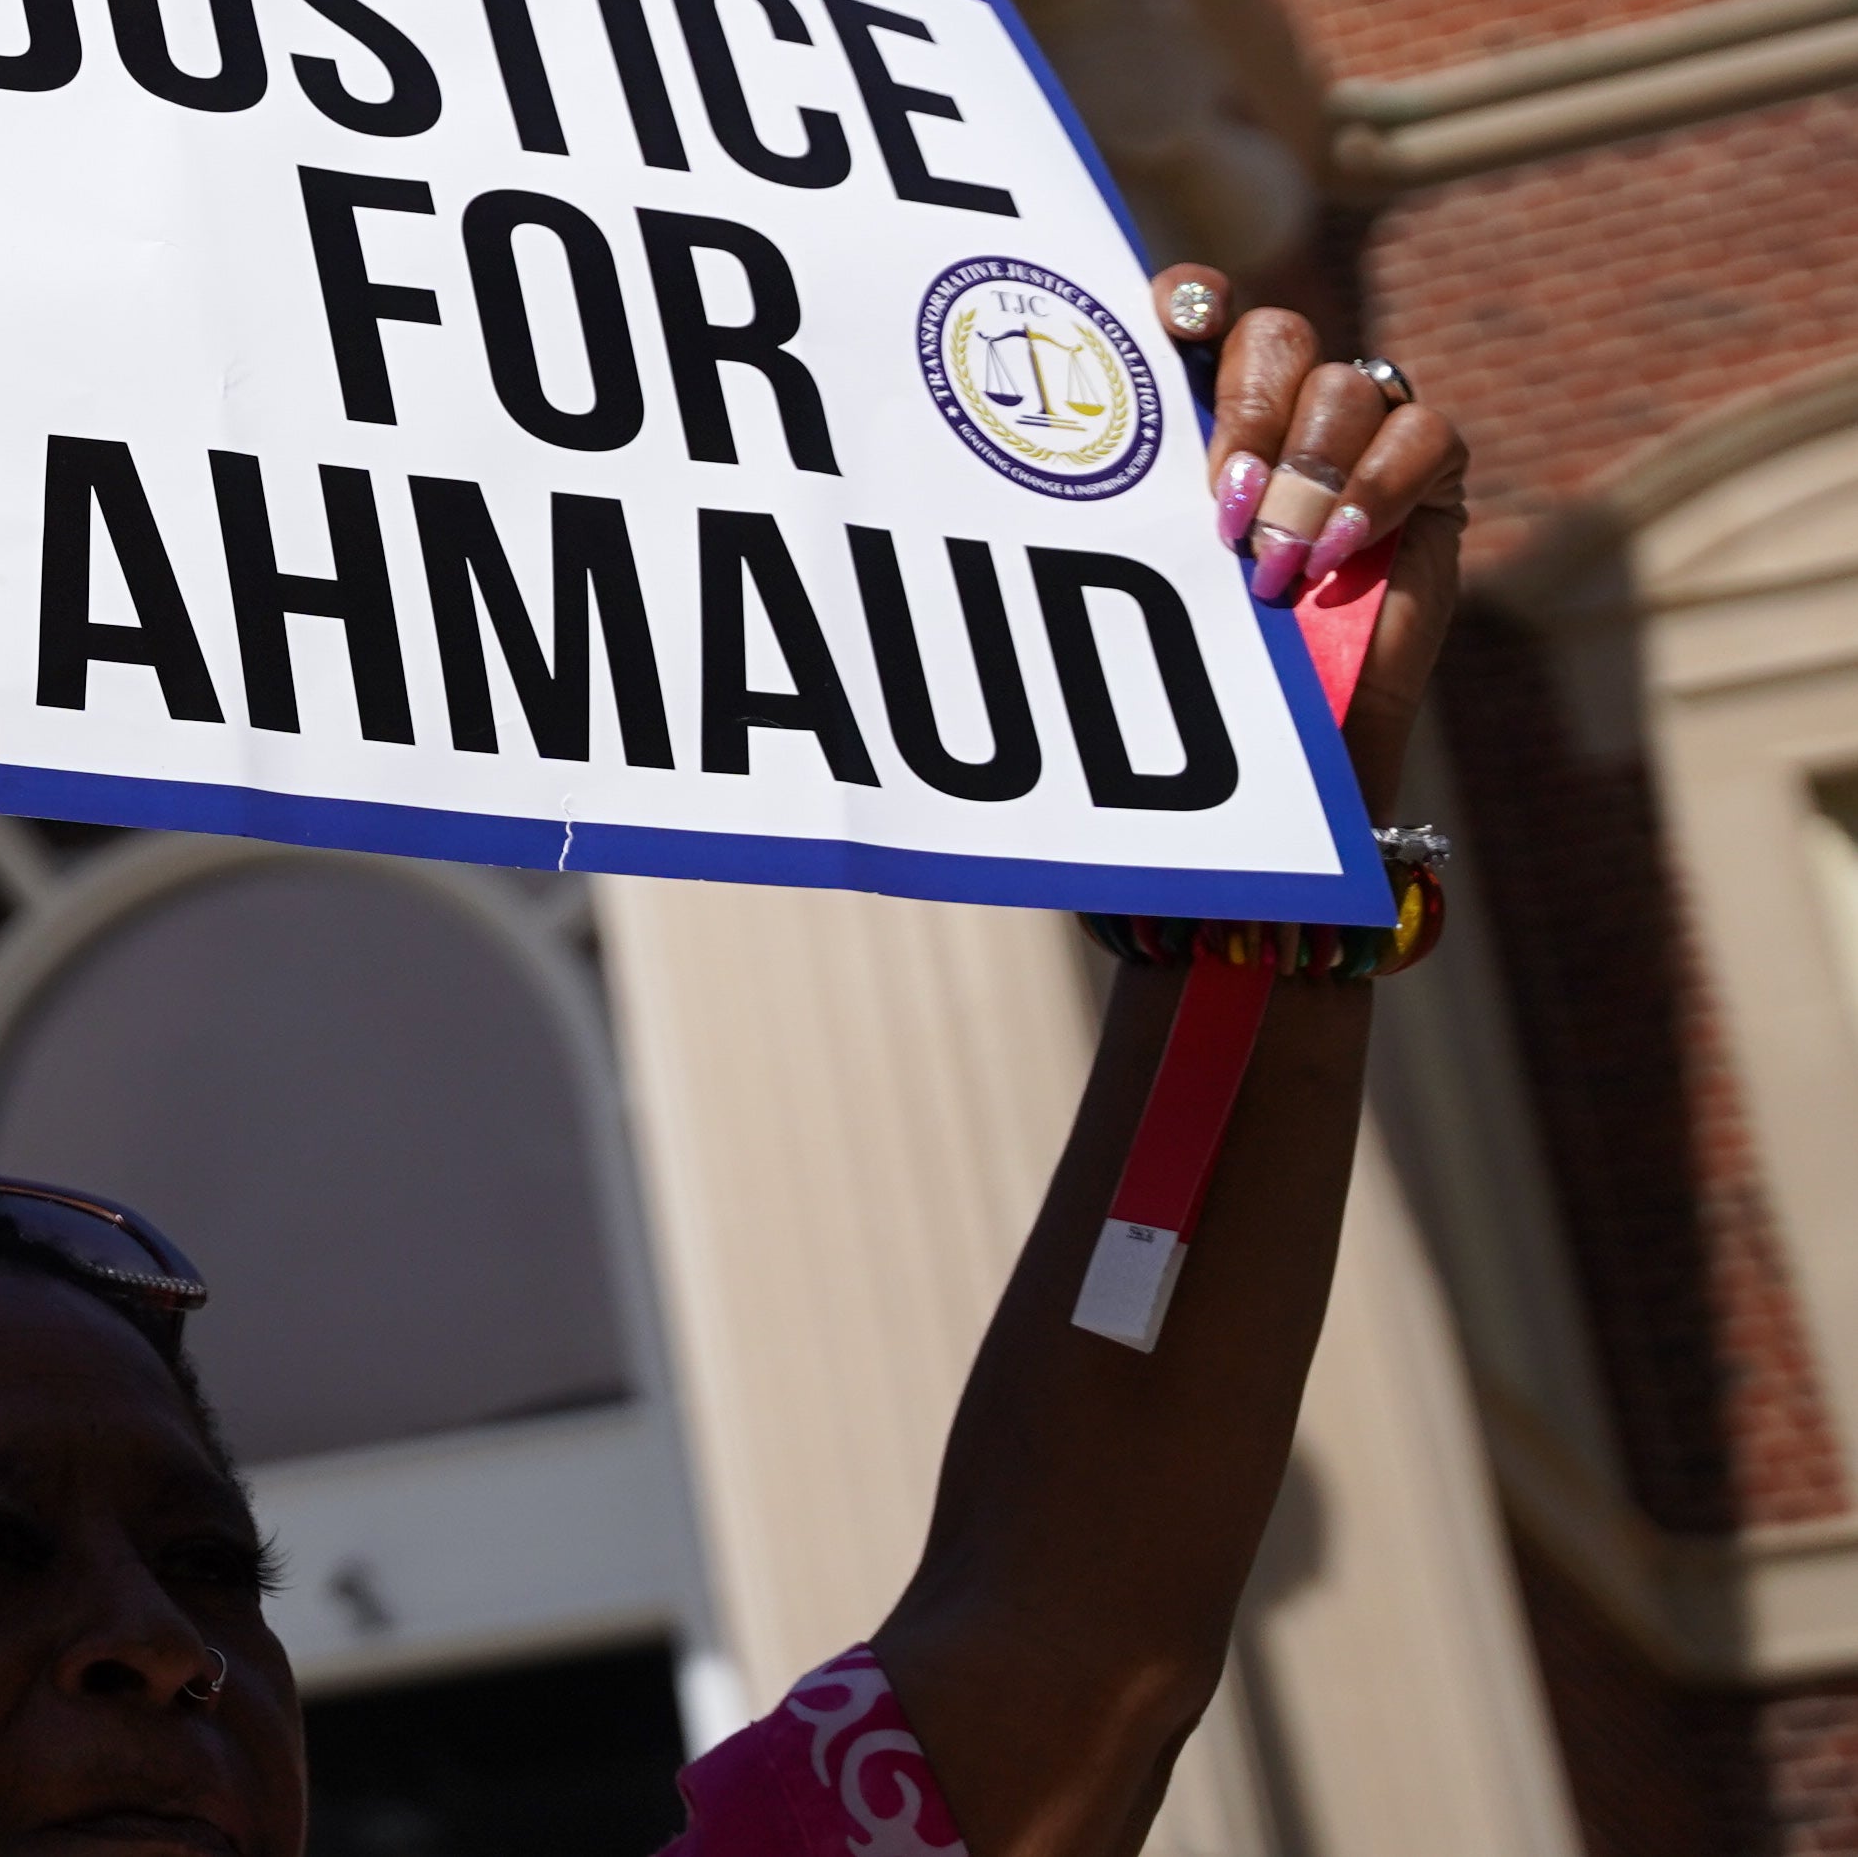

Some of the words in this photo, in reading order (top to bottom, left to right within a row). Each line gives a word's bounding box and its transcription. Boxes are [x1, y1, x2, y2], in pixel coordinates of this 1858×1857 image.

[298, 165, 842, 476] FOR
[920, 261, 1009, 401] TRANSFORMATIVE
[1003, 263, 1093, 312] JUSTICE
[1093, 309, 1160, 425] COALITION
[990, 290, 1050, 318] TJC
[957, 423, 1012, 472] IGNITING
[1010, 468, 1064, 493] CHANGE
[1064, 484, 1074, 496] &
[1074, 473, 1129, 495] INSPIRING
[1125, 442, 1154, 478] ACTION
[36, 435, 1238, 811] AHMAUD
